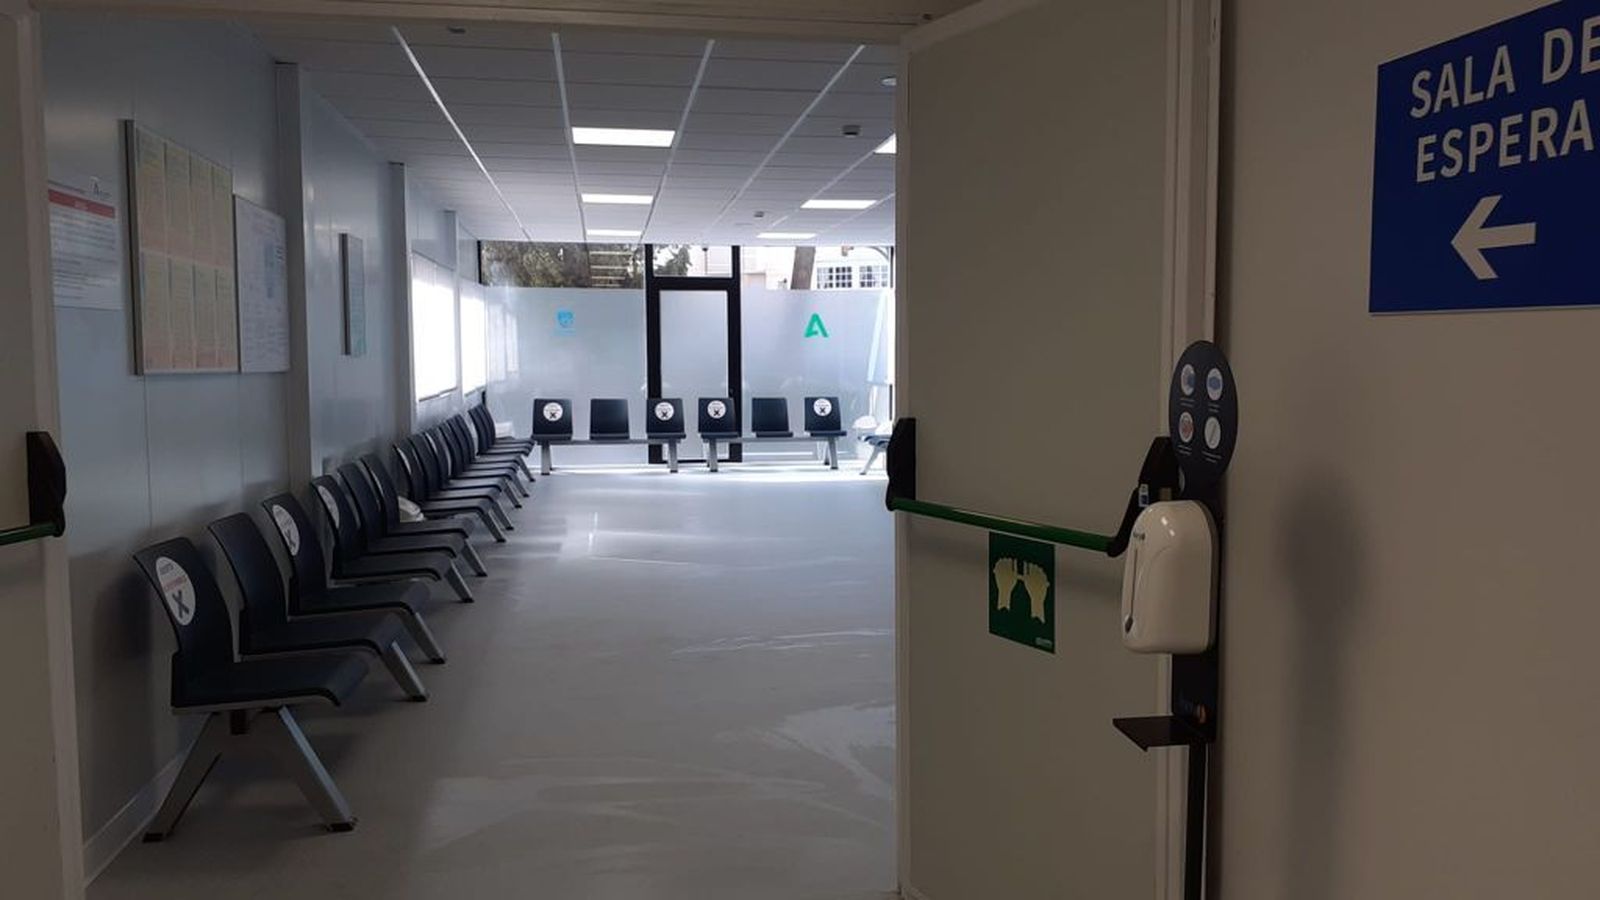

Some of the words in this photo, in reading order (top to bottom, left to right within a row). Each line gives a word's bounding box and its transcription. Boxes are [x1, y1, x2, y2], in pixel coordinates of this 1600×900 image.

[1410, 45, 1516, 119] SALA
[1542, 15, 1600, 84] DE
[1416, 99, 1594, 183] ESPERA
